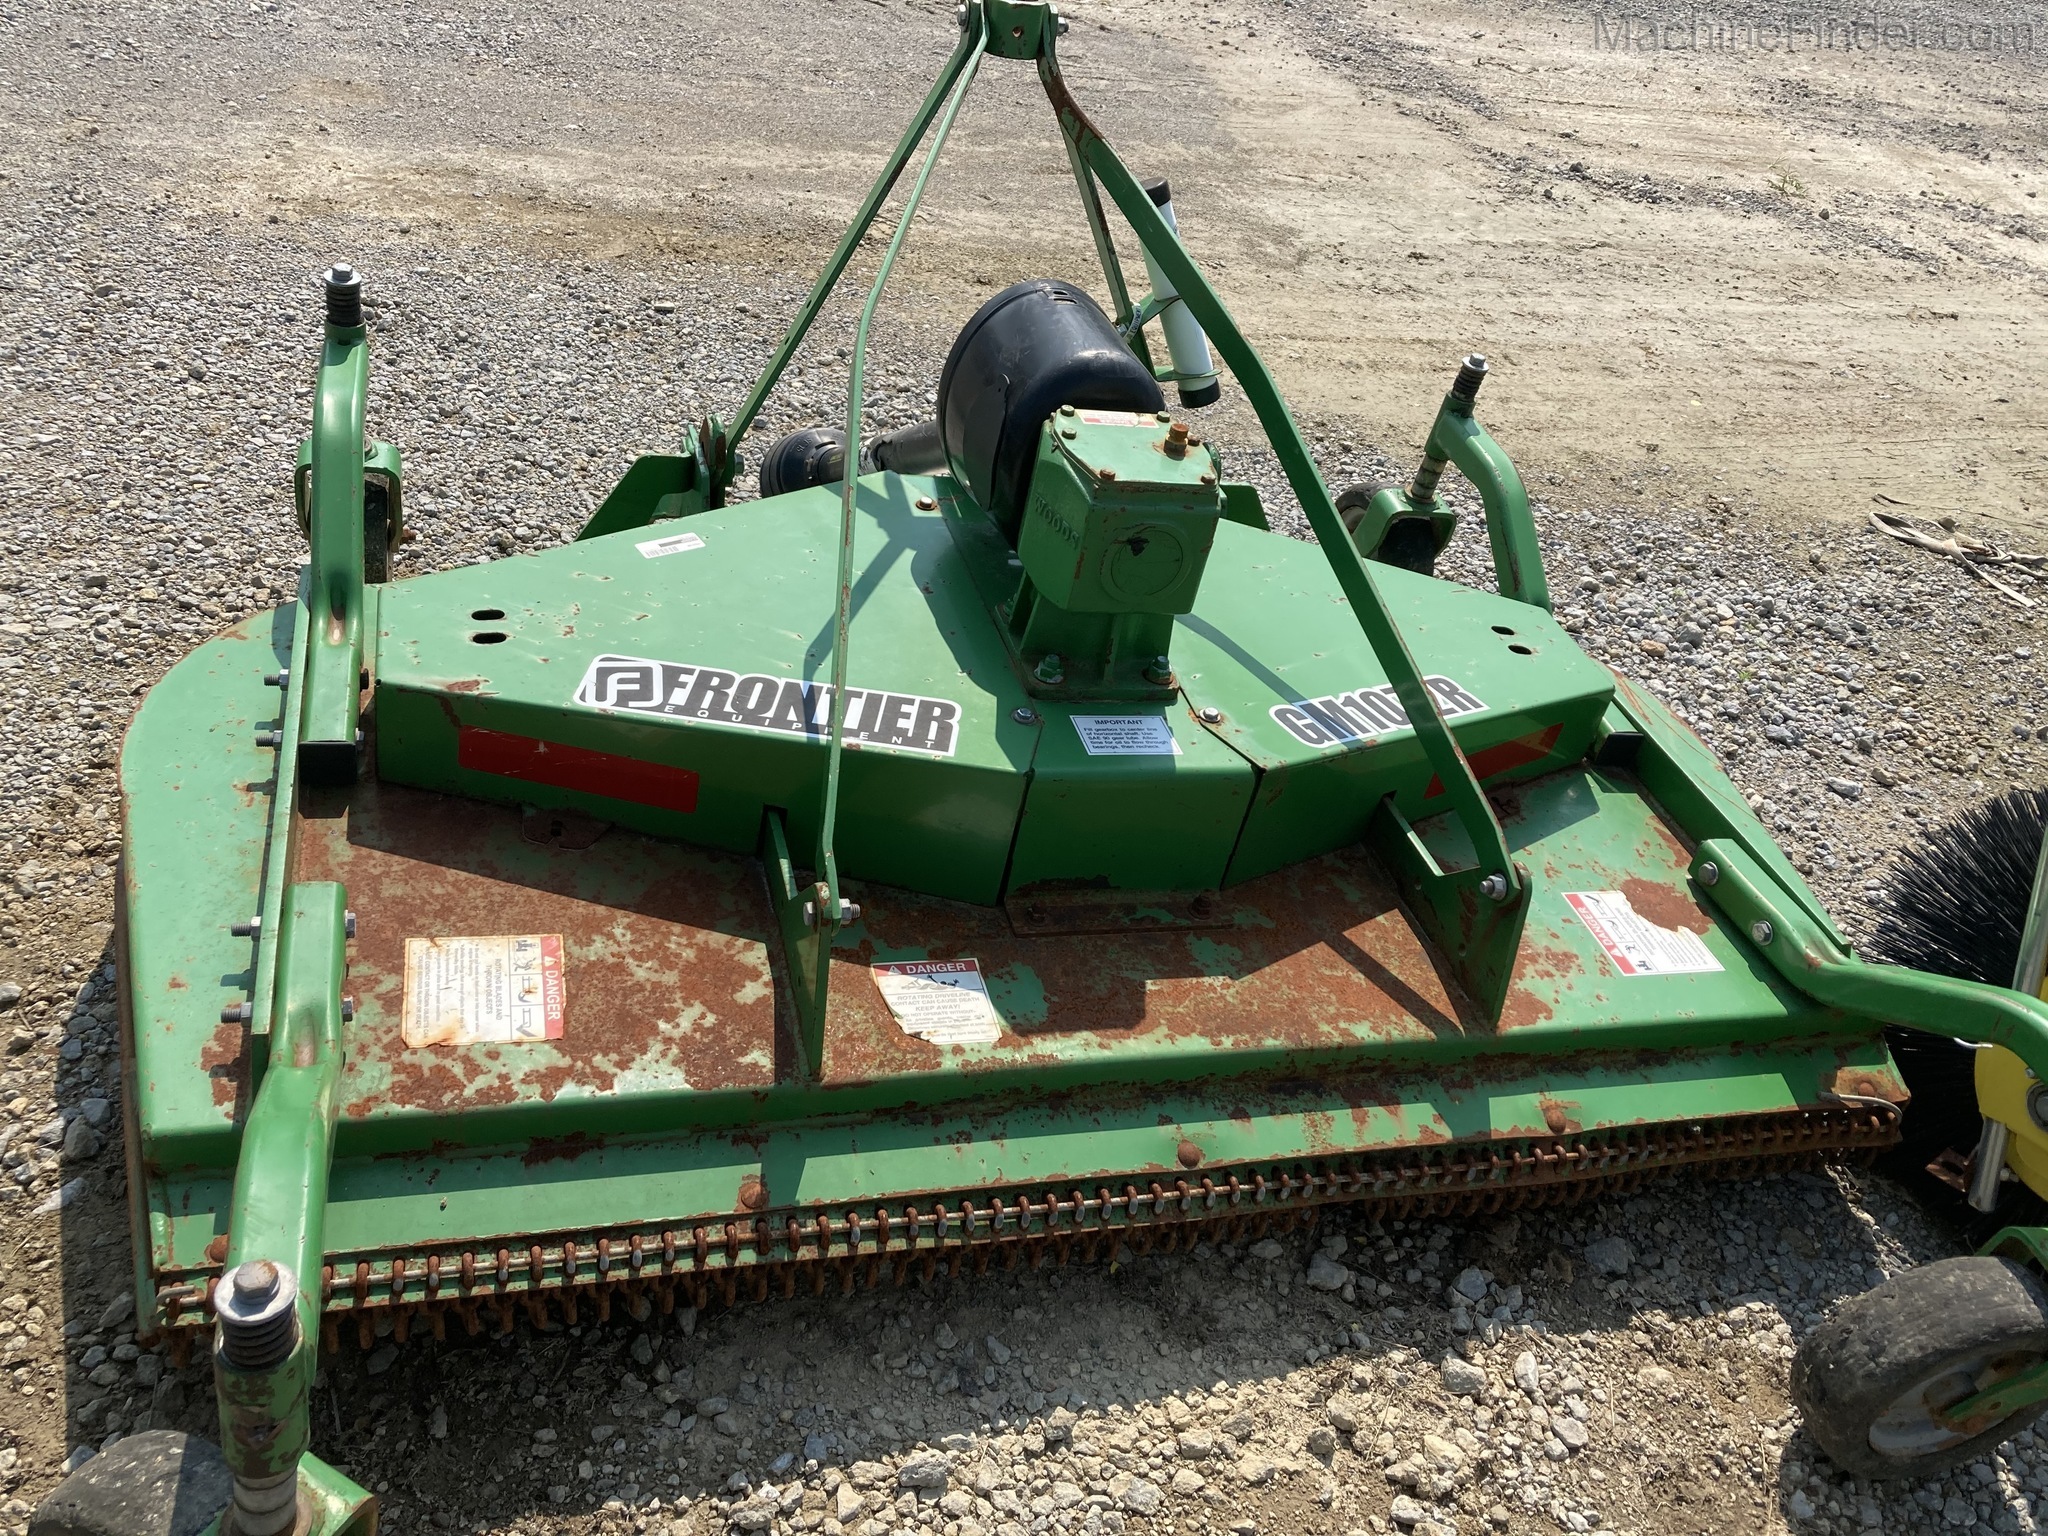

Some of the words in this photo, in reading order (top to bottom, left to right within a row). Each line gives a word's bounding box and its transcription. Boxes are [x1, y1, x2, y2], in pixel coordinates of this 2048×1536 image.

[1035, 493, 1080, 549] WOODS
[664, 658, 957, 743] FRONTIER
[1272, 676, 1486, 746] GM10R
[1576, 906, 1614, 945] DANGER
[906, 963, 967, 974] DANGER
[485, 988, 493, 1014] OBJECTS
[495, 1007, 503, 1020] AND
[545, 969, 561, 1020] DANGER
